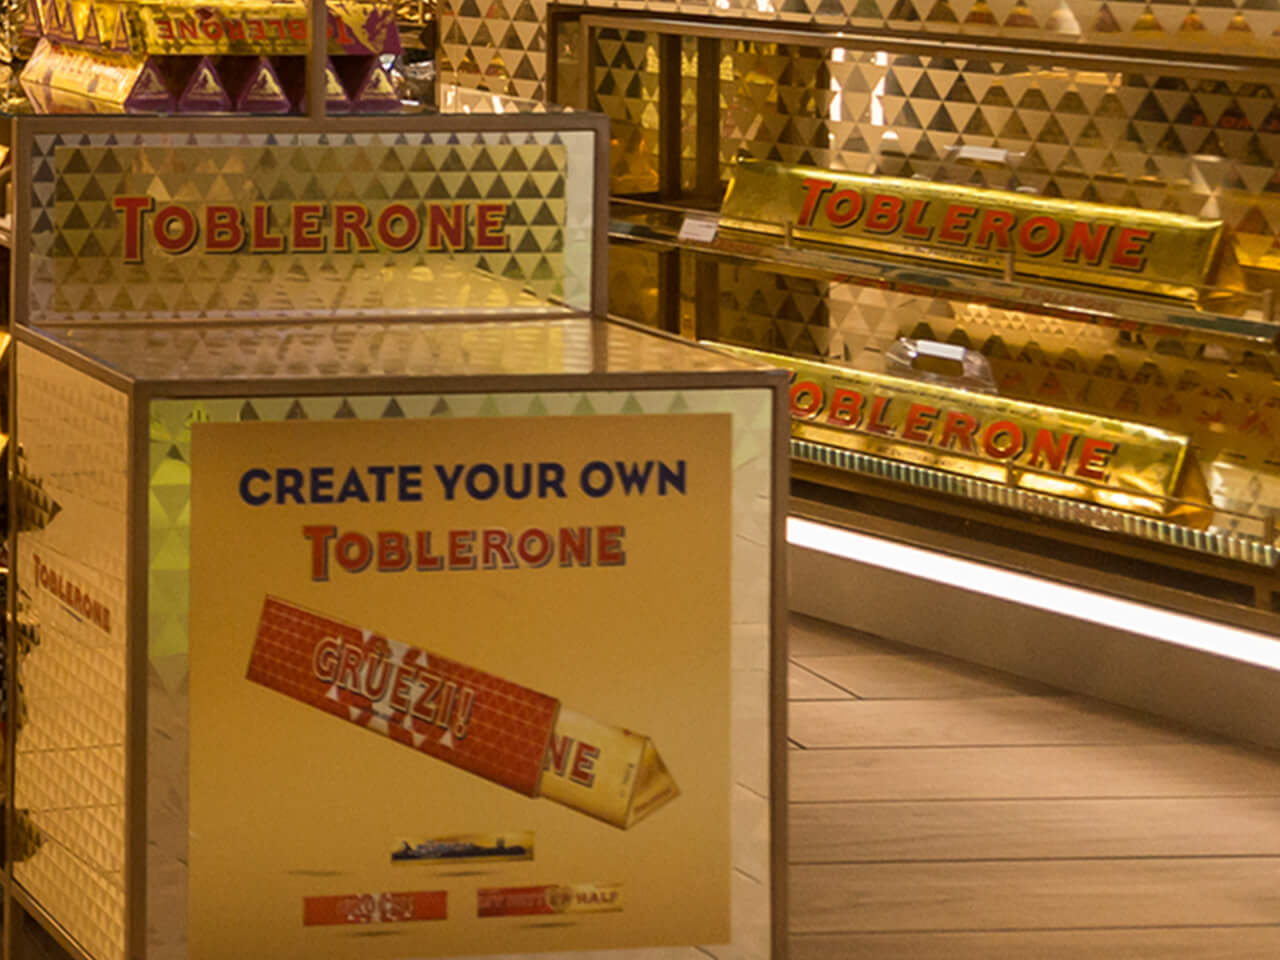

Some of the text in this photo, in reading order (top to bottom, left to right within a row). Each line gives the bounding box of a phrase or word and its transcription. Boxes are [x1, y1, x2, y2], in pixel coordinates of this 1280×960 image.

[157, 17, 355, 44] TBLERONE
[113, 195, 510, 264] TOBLERONE
[797, 178, 1154, 272] TOBLERONE
[789, 372, 1117, 482] OBLERONE
[239, 460, 687, 507] CREATE YOUR OWN
[303, 524, 627, 582] TOBLERONE
[32, 553, 111, 634] TOBLERONE
[313, 635, 477, 740] GRÜEZI!
